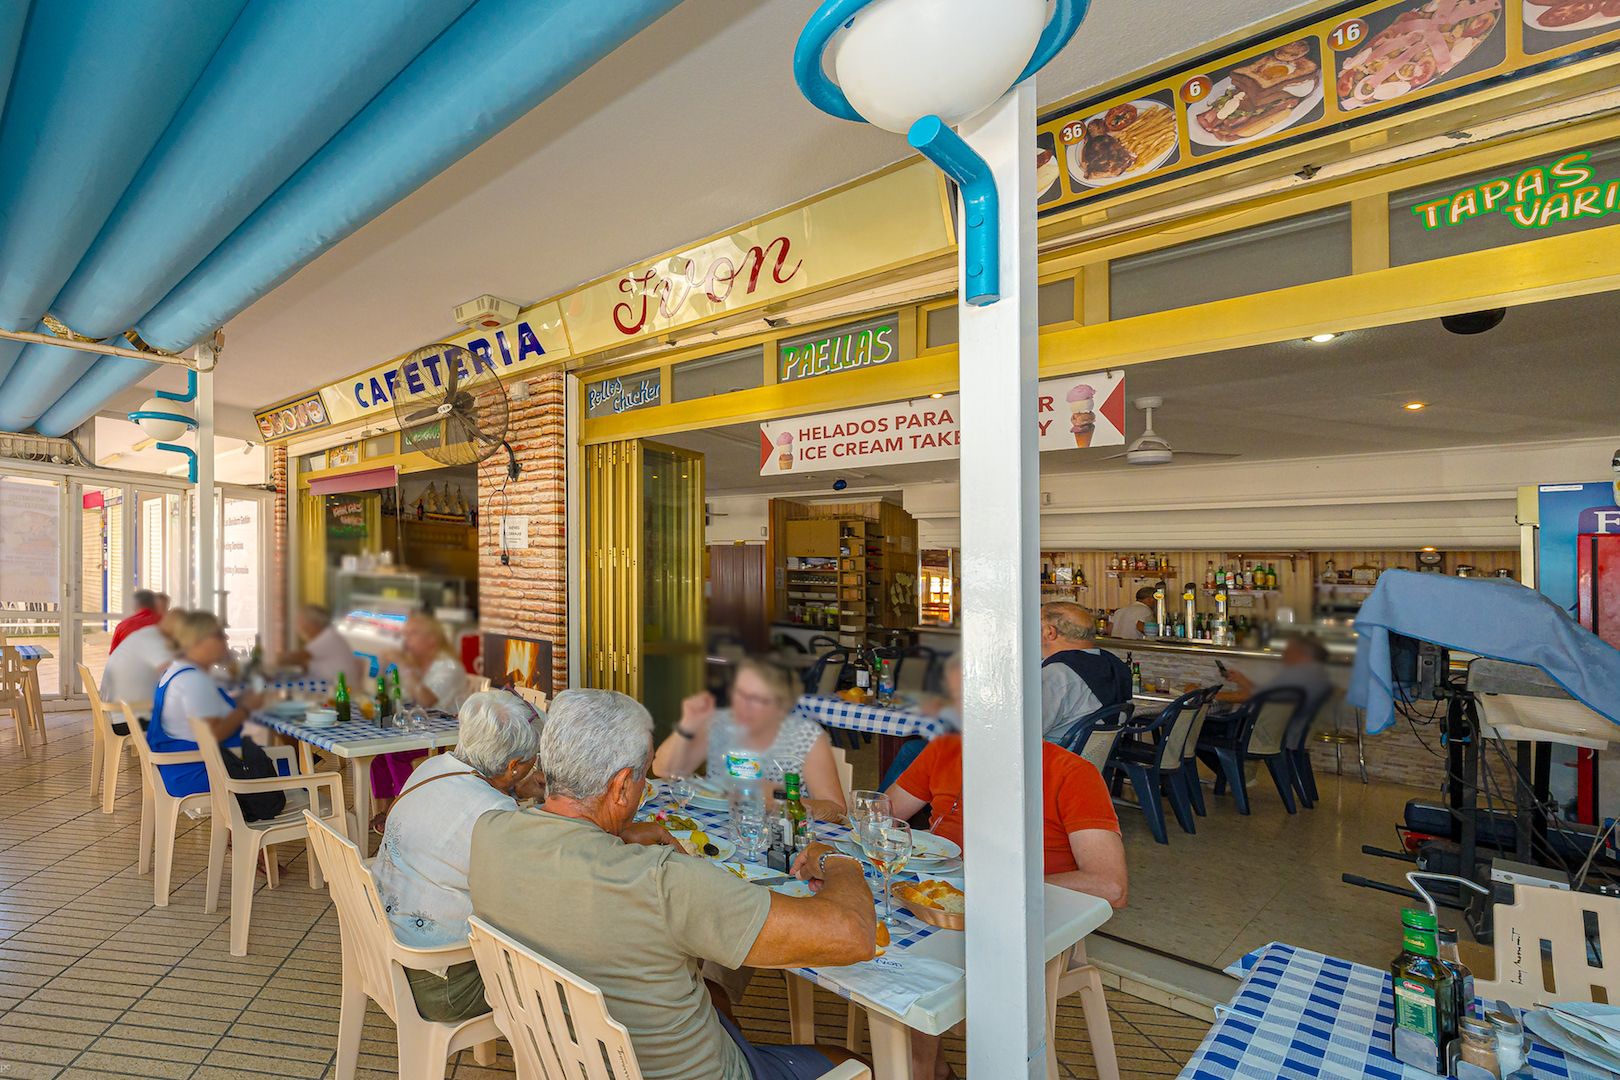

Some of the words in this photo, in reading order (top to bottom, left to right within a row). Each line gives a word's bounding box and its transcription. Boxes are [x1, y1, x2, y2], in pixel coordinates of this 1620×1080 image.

[1332, 23, 1361, 46] 16
[1189, 81, 1202, 97] 6
[1063, 124, 1083, 142] 36
[1412, 152, 1594, 230] TAPAS
[1503, 180, 1620, 229] VARI
[354, 321, 546, 408] CAFETERIA
[781, 325, 892, 381] PAELLAS
[799, 417, 889, 442] HELADOS
[895, 409, 954, 431] PARA
[800, 445, 827, 461] ICE
[833, 437, 903, 458] CREAM
